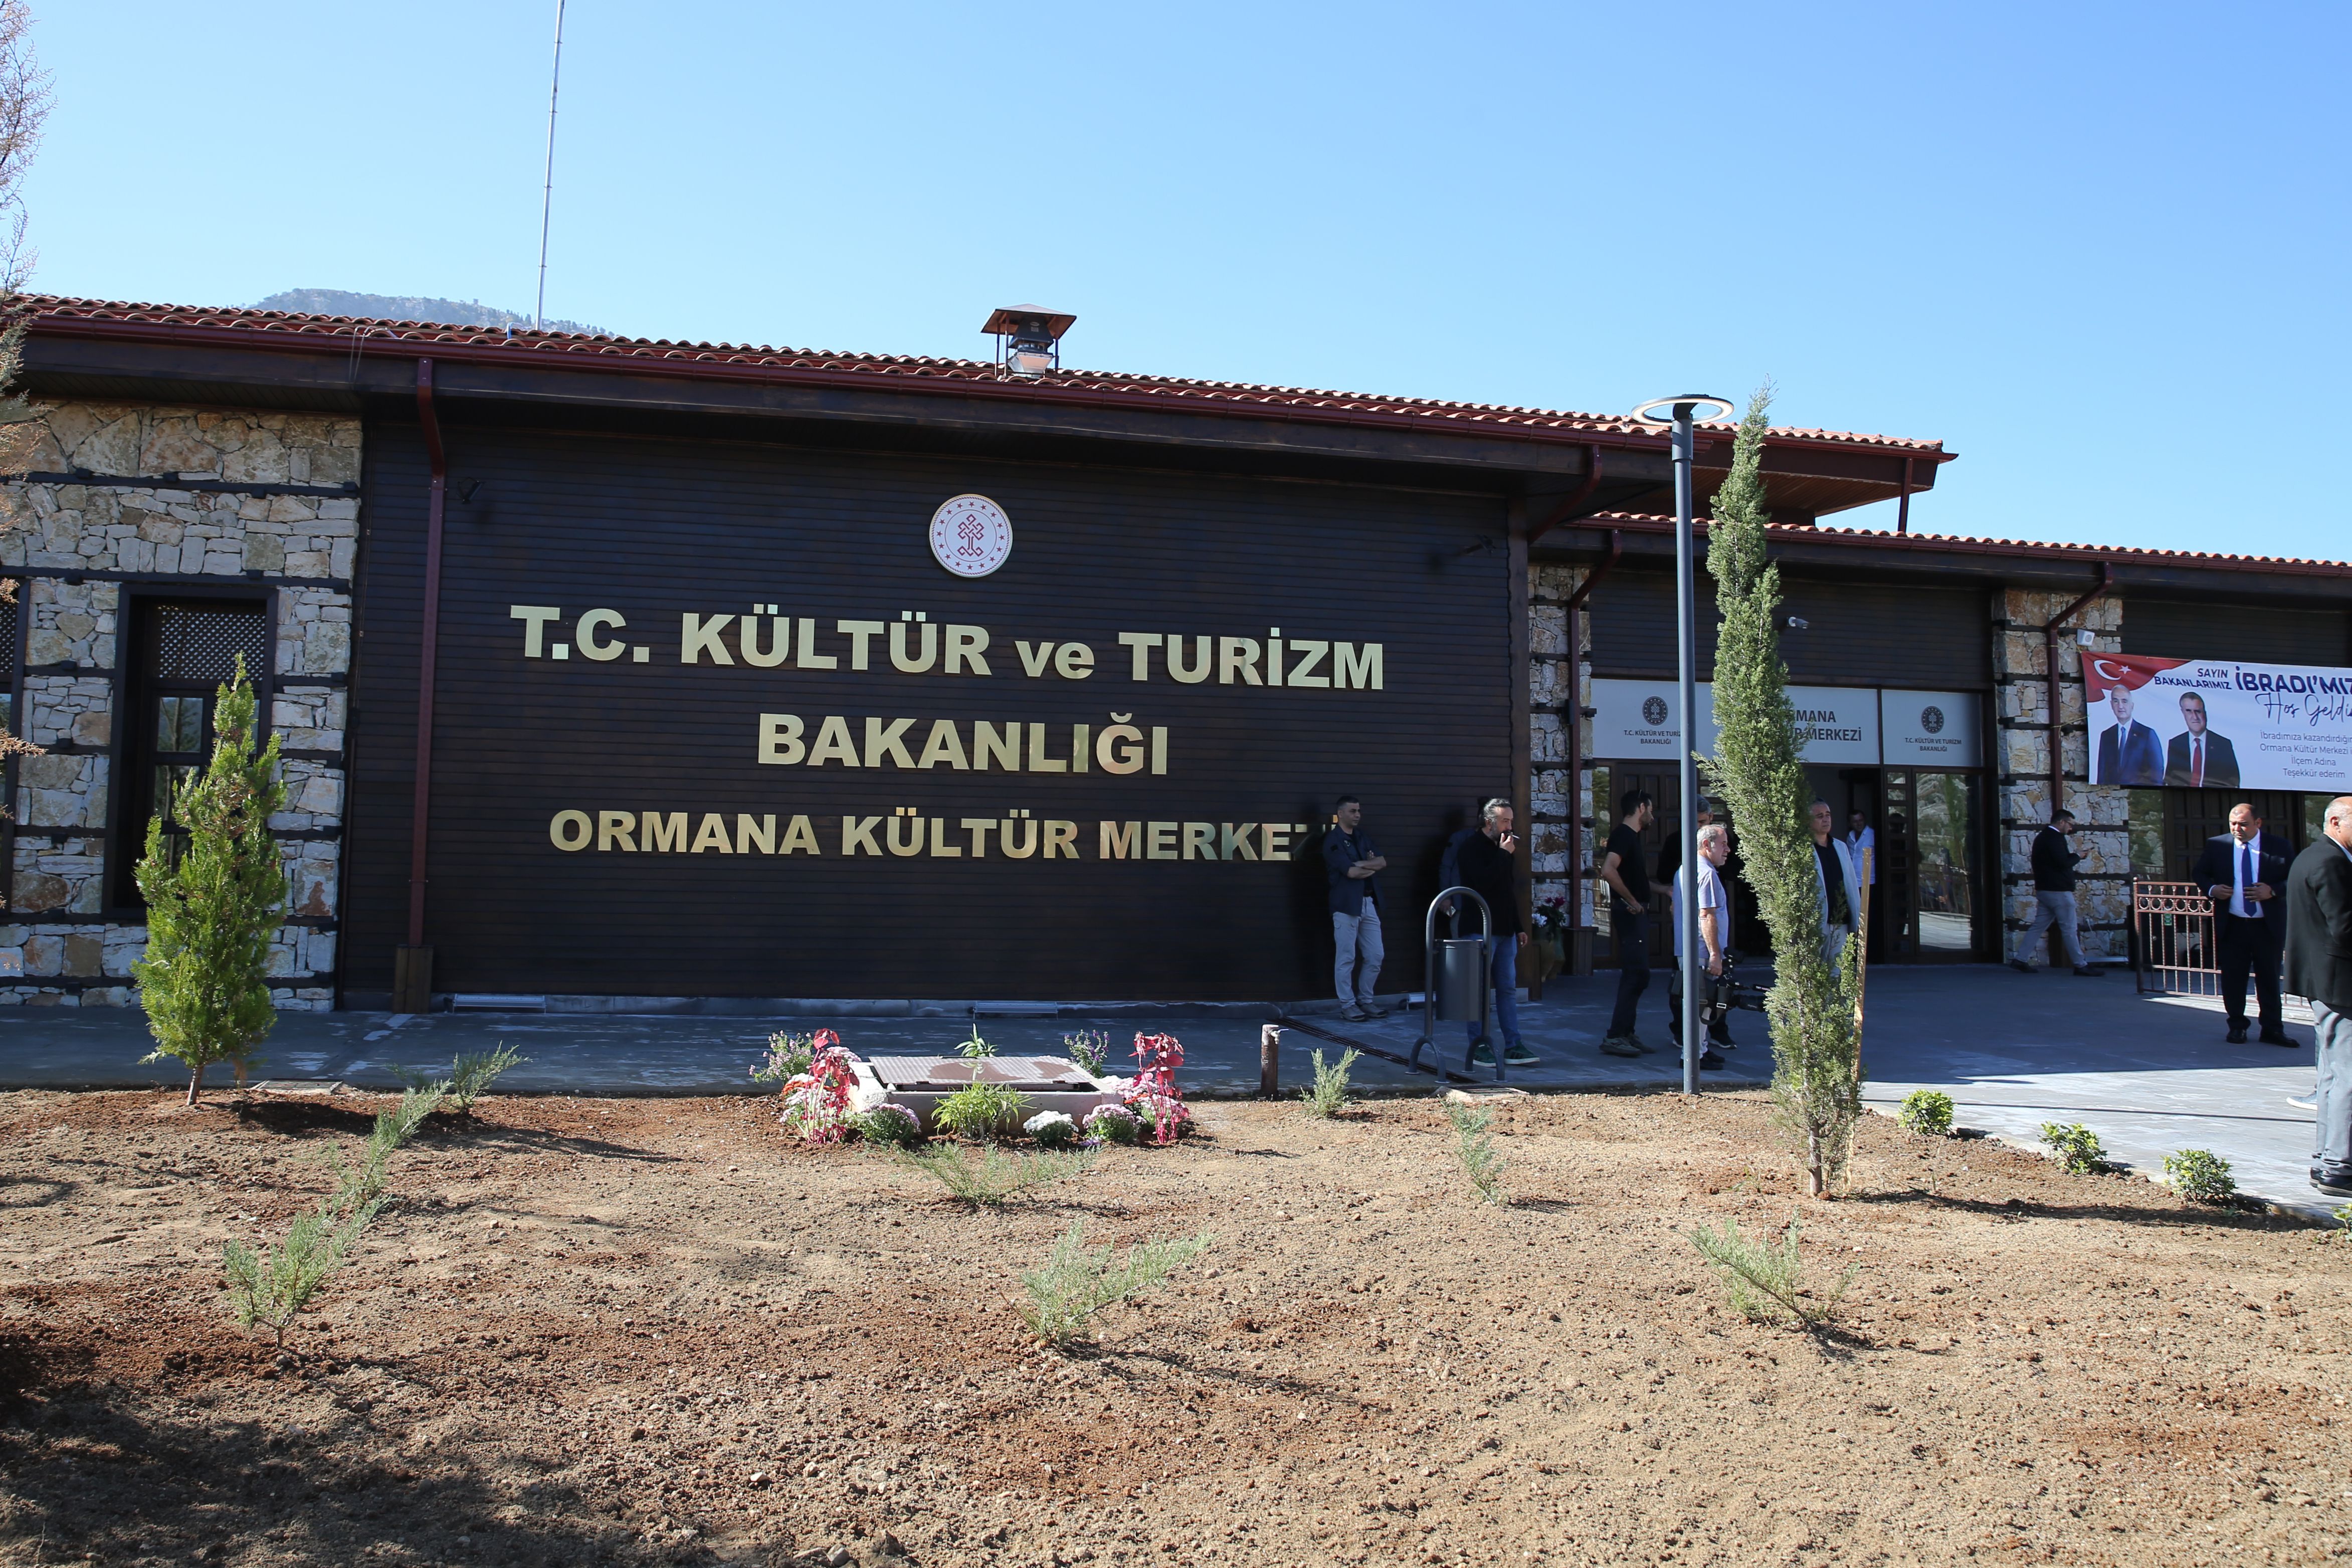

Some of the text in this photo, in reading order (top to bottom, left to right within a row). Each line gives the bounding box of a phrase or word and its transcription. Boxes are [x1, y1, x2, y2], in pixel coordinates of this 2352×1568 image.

[510, 604, 1383, 689] T.C. KÜLTÜR ve TURİZM
[2198, 668, 2228, 678] SAYIN
[2154, 676, 2232, 690] BAKANLARIMIZ
[2255, 692, 2352, 726] Hoş Geldi
[1796, 710, 1837, 722] MANA
[1808, 727, 1862, 741] MERKEZİ
[2260, 729, 2302, 741] İbradımıza
[758, 712, 1167, 774] BAKANLIĞI
[2260, 743, 2292, 752] Ormana
[2294, 745, 2317, 753] Kültür
[2319, 746, 2348, 754] Merkezi
[2291, 755, 2336, 766] İlçem Adına
[2283, 768, 2317, 778] Teşekkür
[550, 807, 1338, 861] ORMANA KÜLTÜR MERKE
